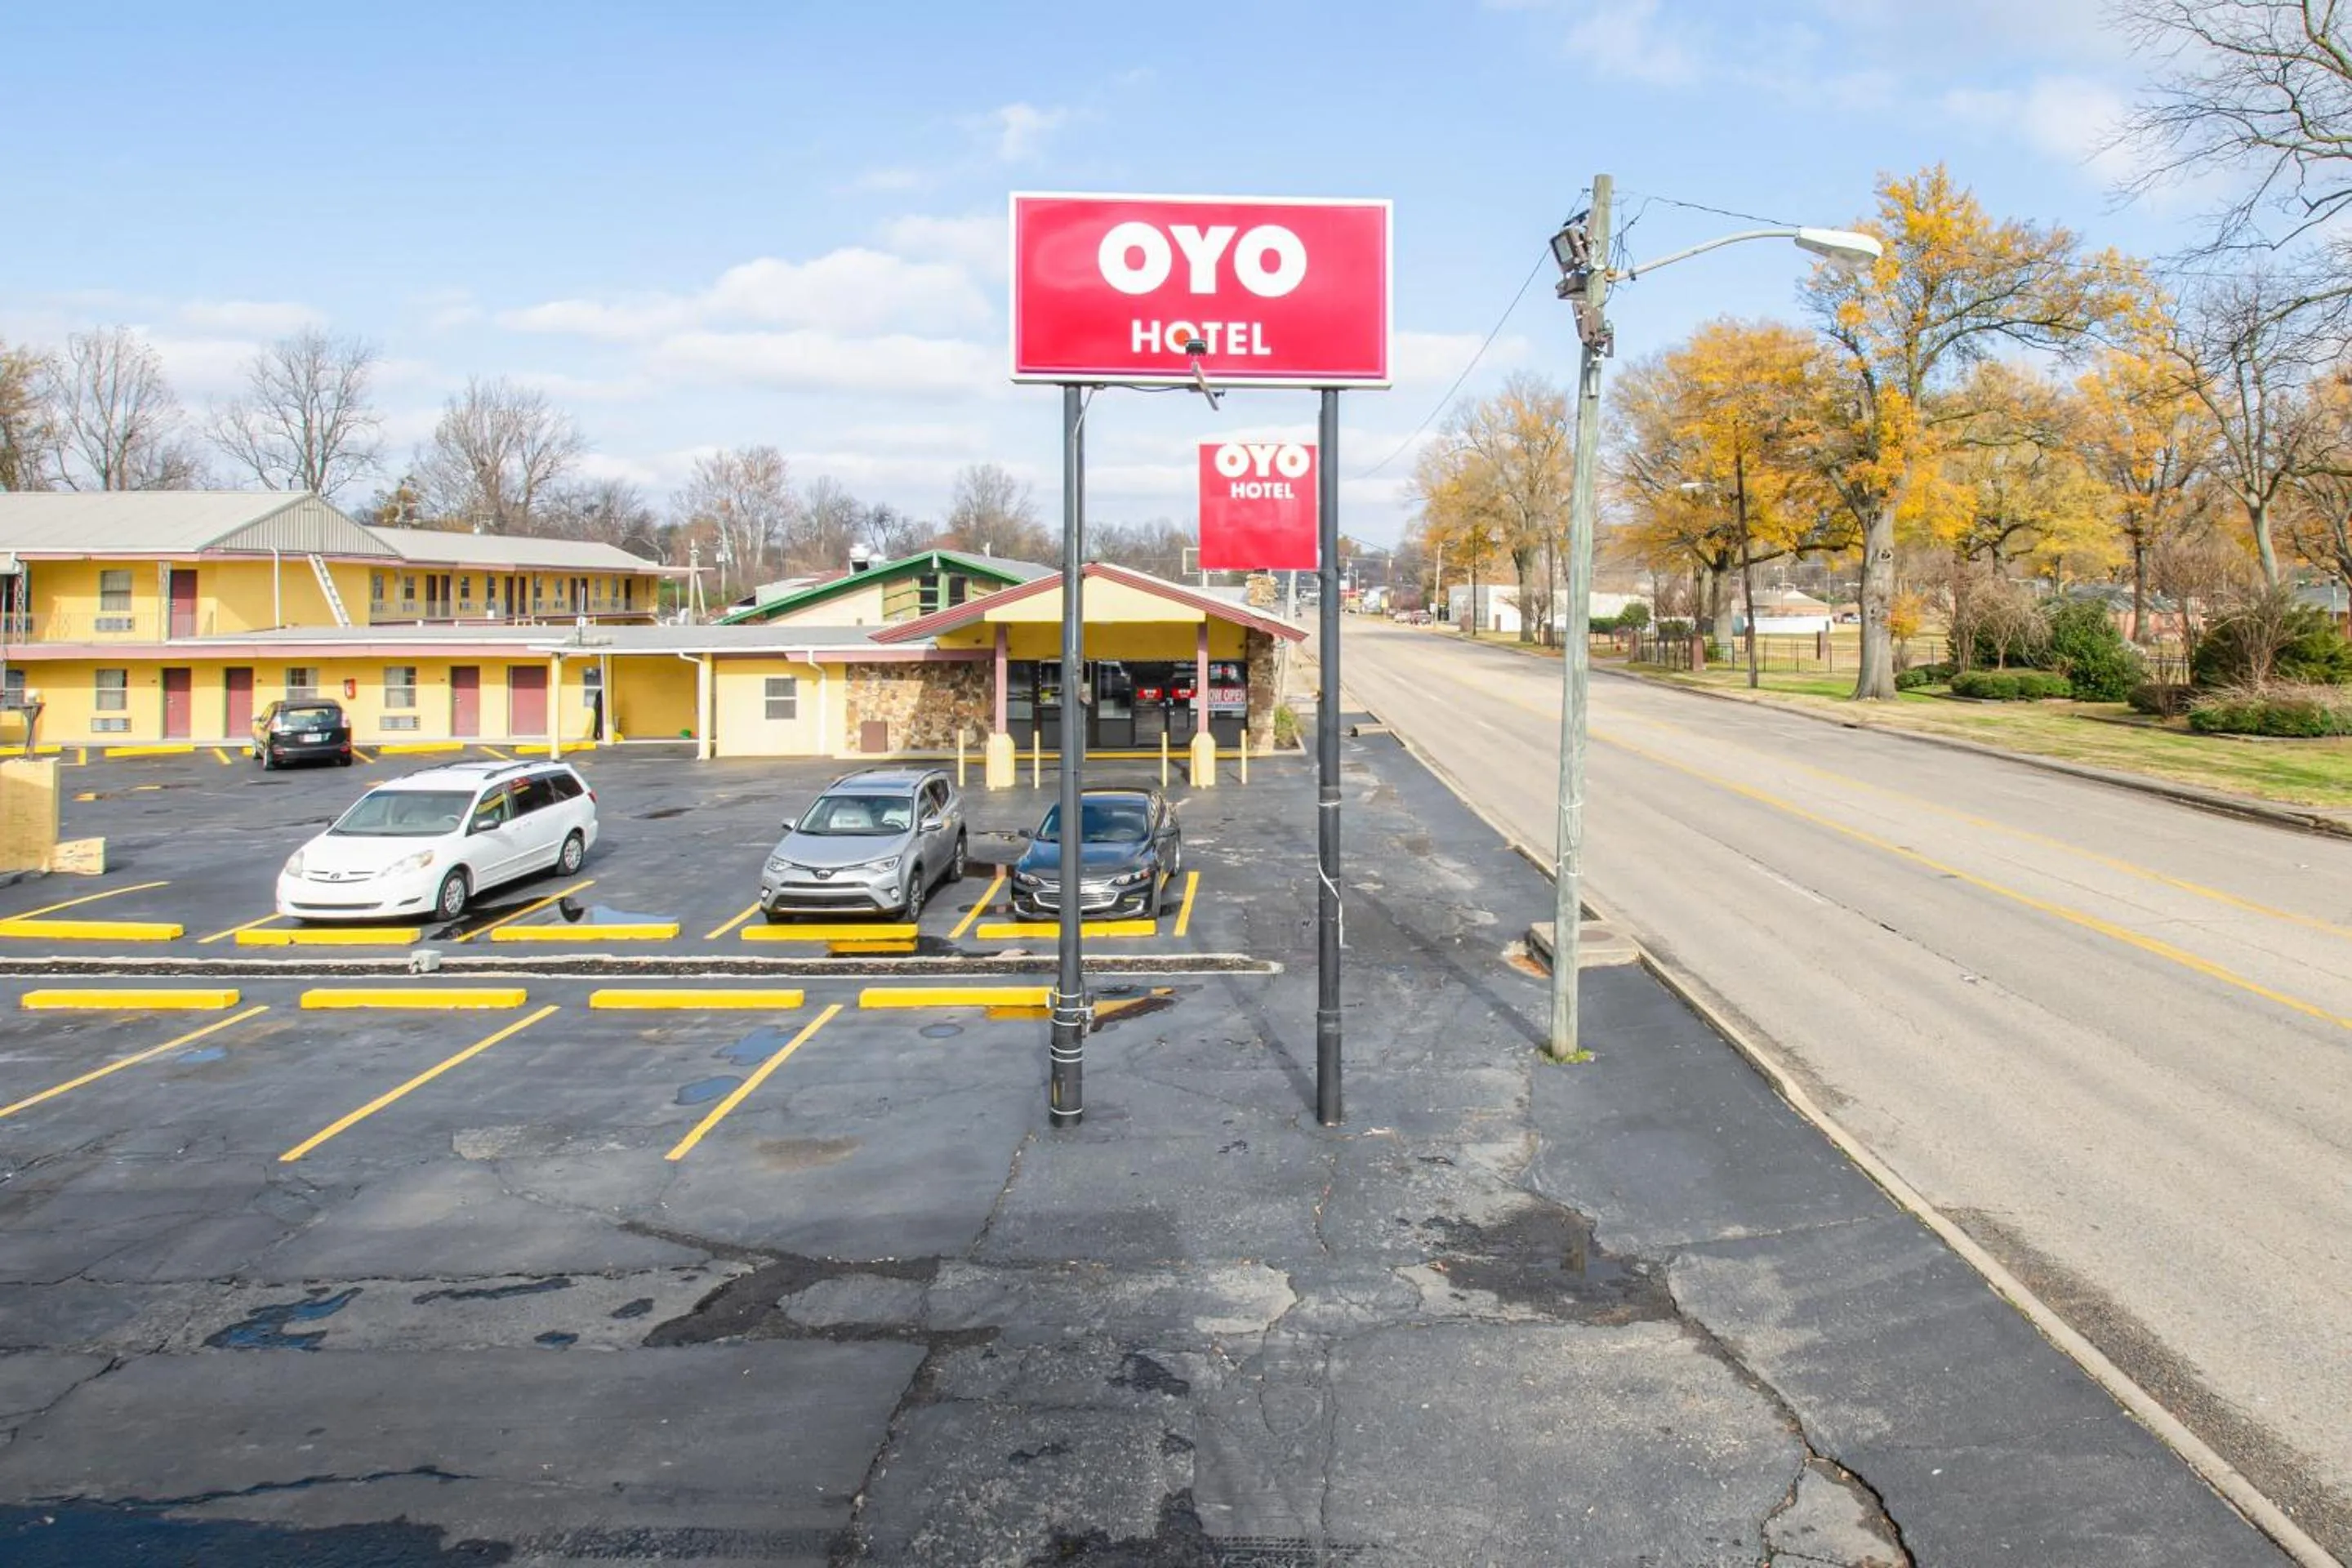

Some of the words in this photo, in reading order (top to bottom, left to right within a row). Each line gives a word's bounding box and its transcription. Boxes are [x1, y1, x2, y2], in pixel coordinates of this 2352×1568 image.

[1098, 220, 1307, 296] OYO
[1132, 319, 1272, 355] HOTEL
[1214, 443, 1310, 478] OYO
[1231, 482, 1294, 499] HOTEL
[1223, 688, 1245, 702] OPEN
